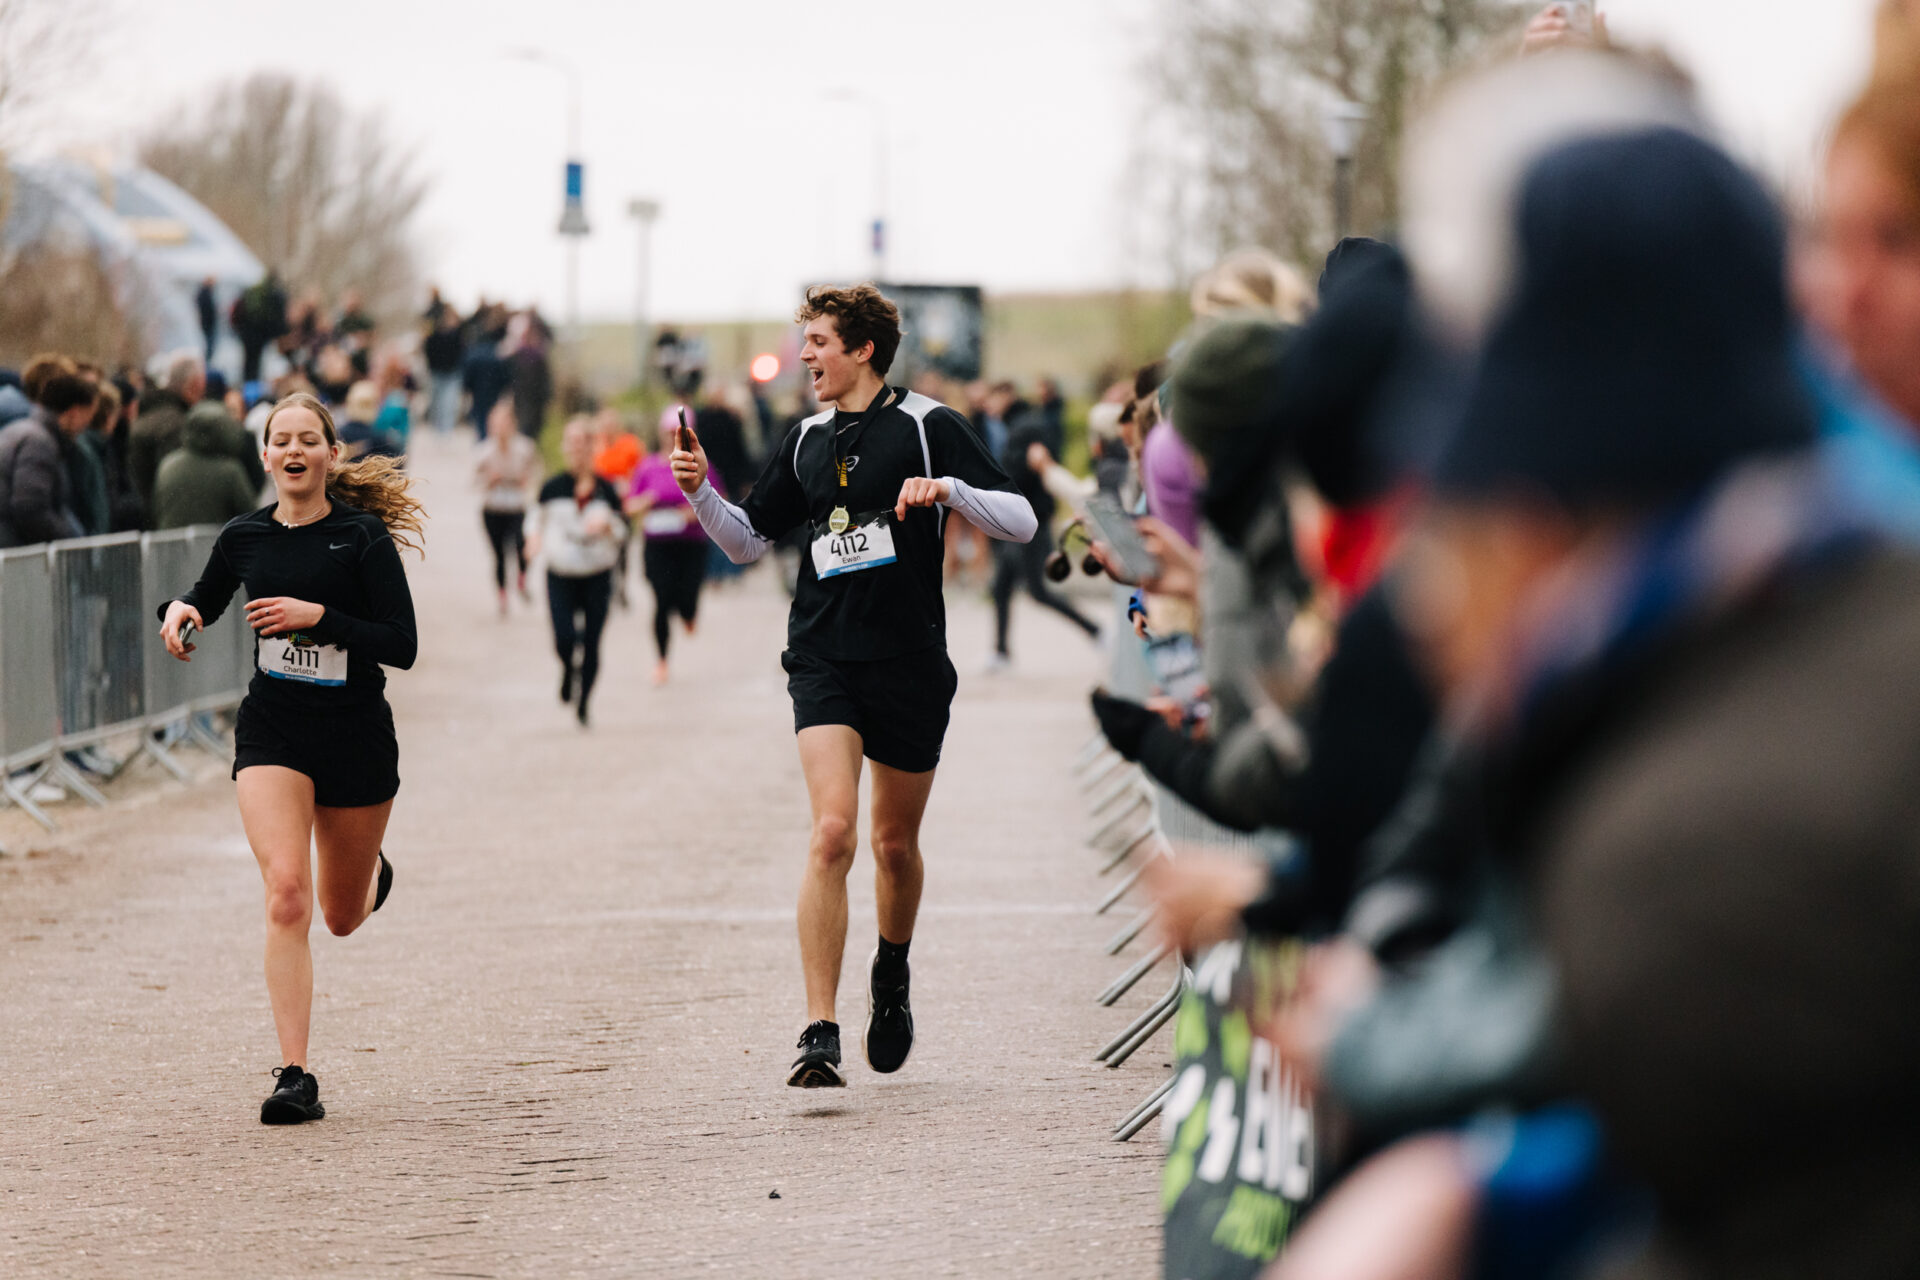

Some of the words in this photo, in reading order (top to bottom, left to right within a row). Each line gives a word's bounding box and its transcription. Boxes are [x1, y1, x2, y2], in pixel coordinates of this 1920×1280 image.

[831, 533, 869, 556] 4112
[842, 556, 861, 564] Ewan
[282, 647, 319, 668] 4111
[283, 666, 317, 676] Charlotte
